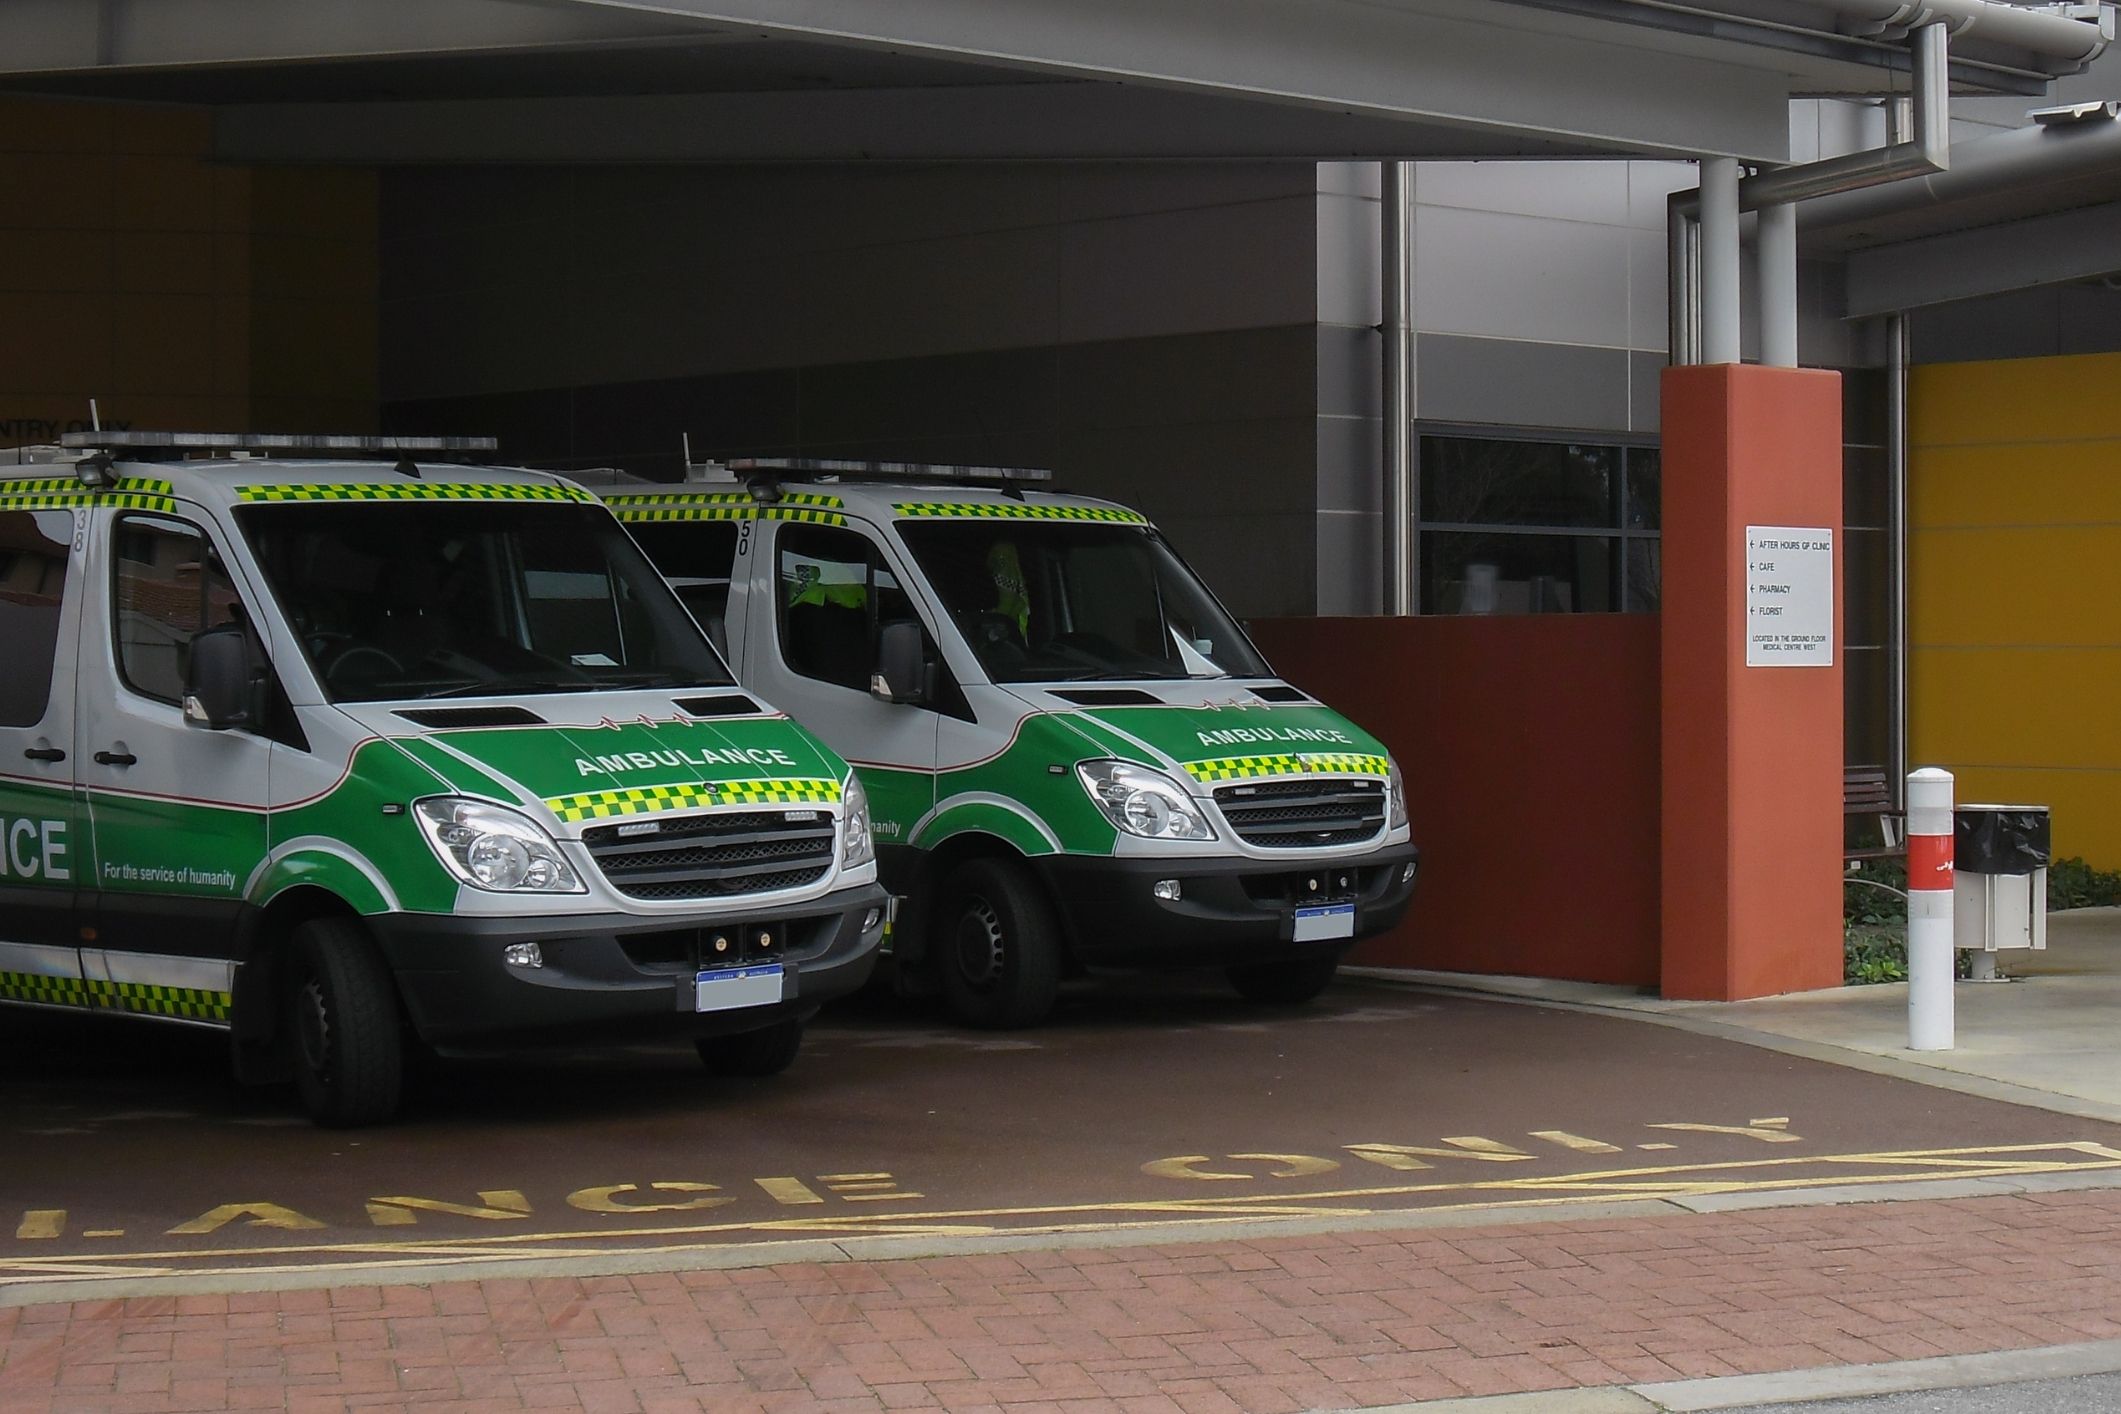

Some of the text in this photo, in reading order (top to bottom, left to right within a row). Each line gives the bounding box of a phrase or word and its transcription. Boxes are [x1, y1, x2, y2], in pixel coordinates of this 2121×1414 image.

[1759, 540, 1830, 551] AFTER HOURS GP CLINIC
[1759, 562, 1775, 571] CAFE
[1759, 585, 1791, 594] PHARMACY
[1759, 607, 1783, 616] FLORIST
[1196, 727, 1353, 746] AMBULANCE
[574, 747, 797, 776] AMBULANCE
[104, 862, 236, 891] For the service of humanity
[1140, 1117, 1803, 1181] ONLY
